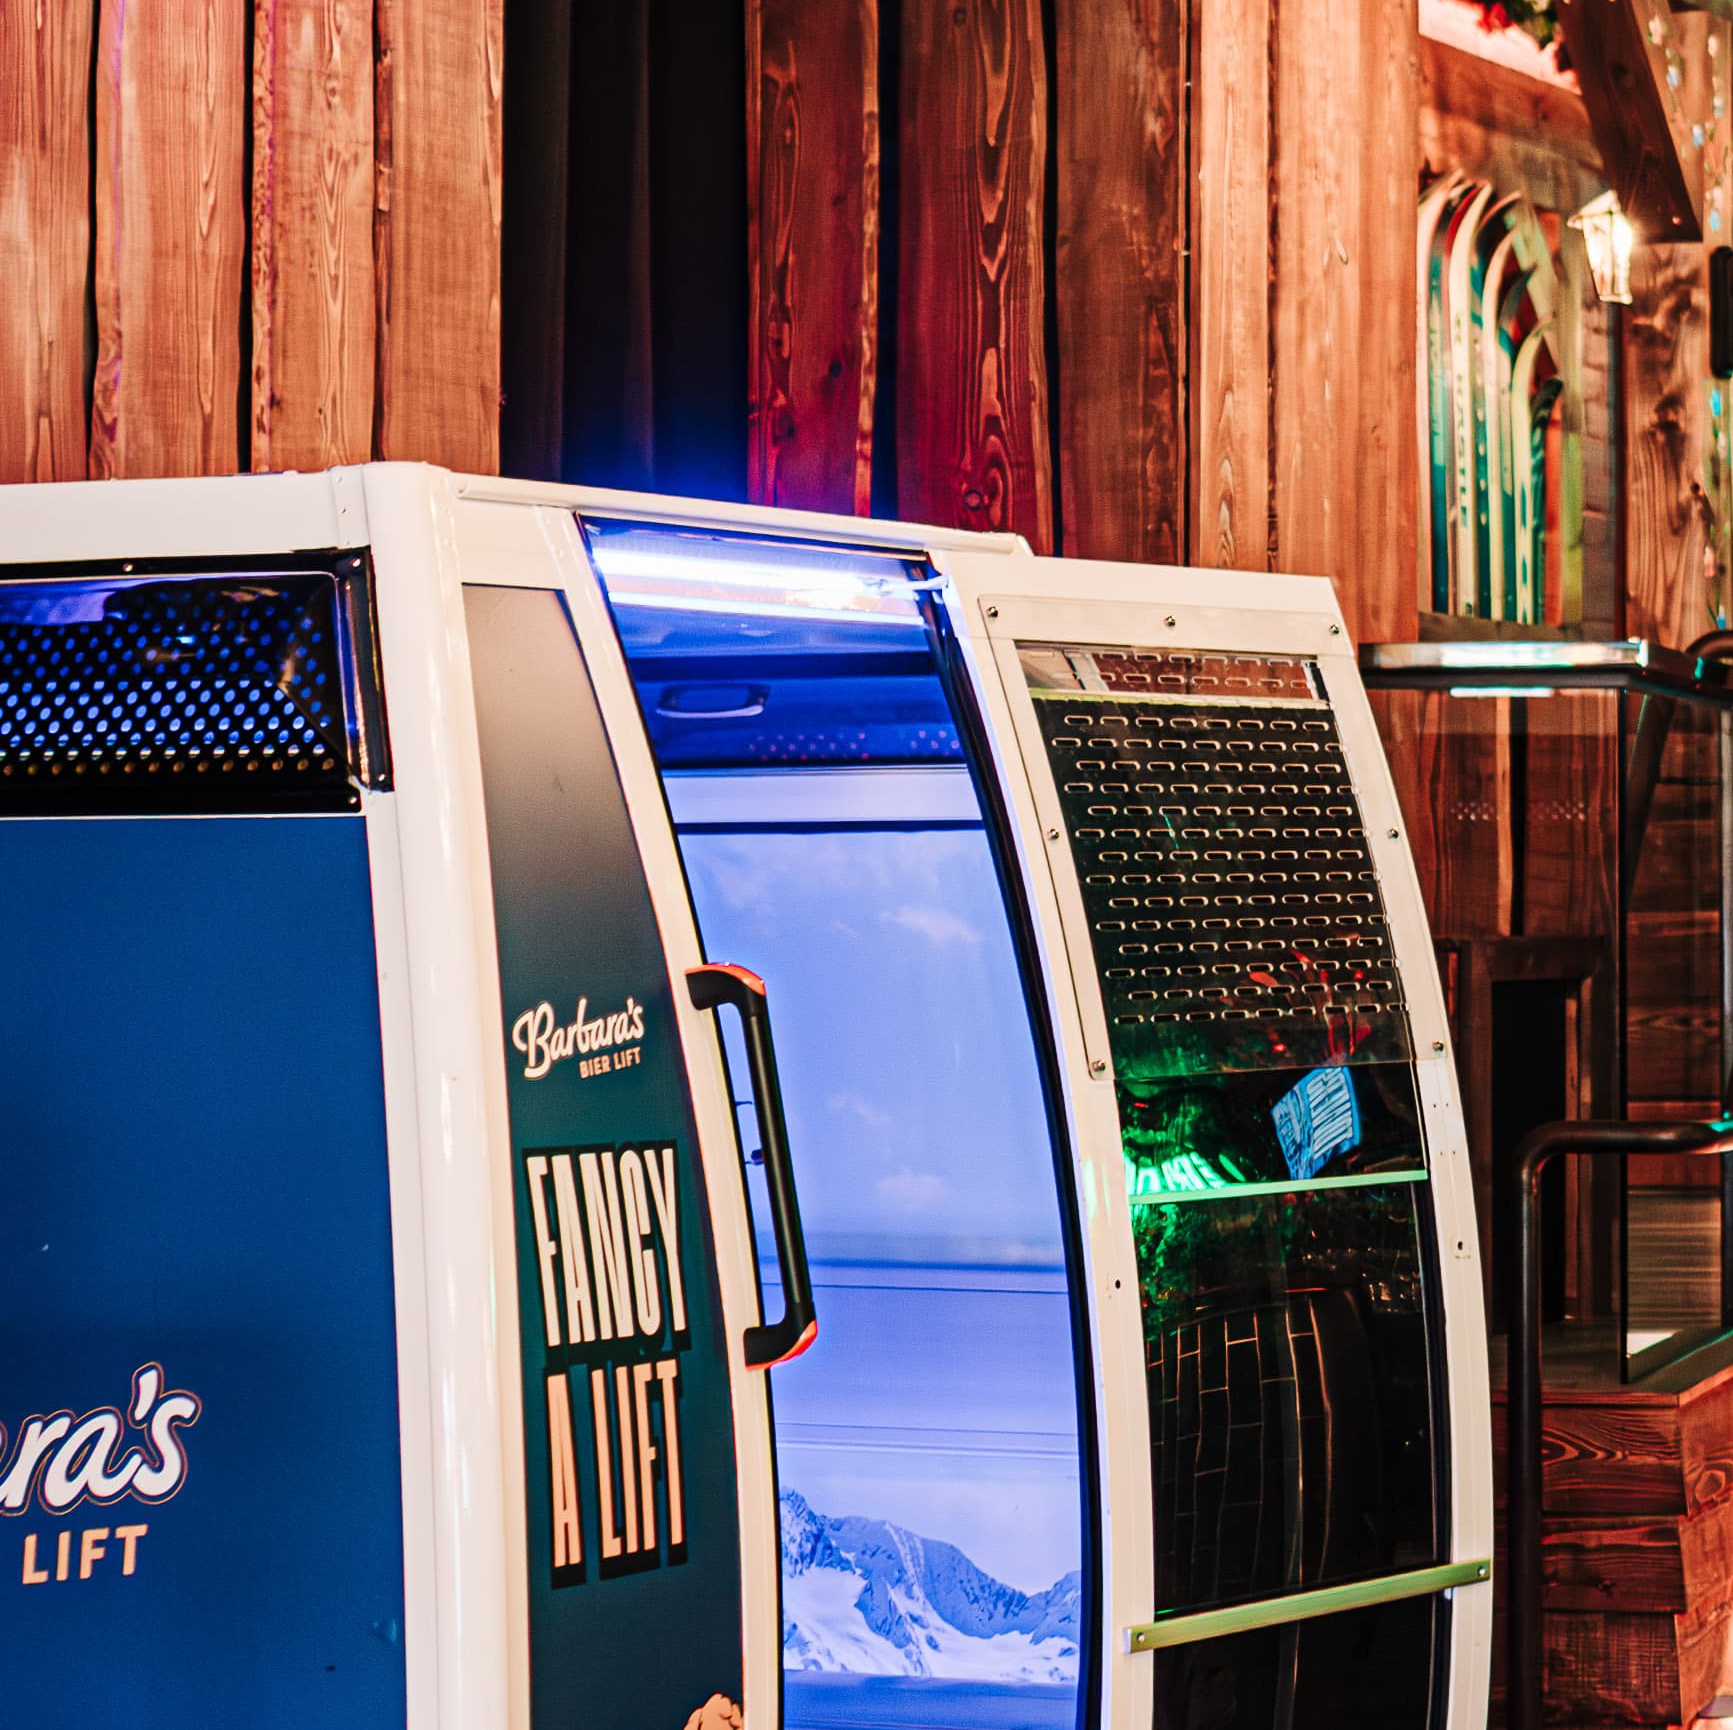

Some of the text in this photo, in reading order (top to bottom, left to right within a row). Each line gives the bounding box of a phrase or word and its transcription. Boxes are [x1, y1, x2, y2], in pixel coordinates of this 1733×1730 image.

[512, 996, 645, 1080] Barbara's
[579, 1046, 641, 1079] BIER LIFT
[526, 1148, 687, 1347] FANCY
[0, 1365, 199, 1512] ra's
[547, 1358, 684, 1568] A LIFT
[22, 1523, 149, 1586] LIFT
